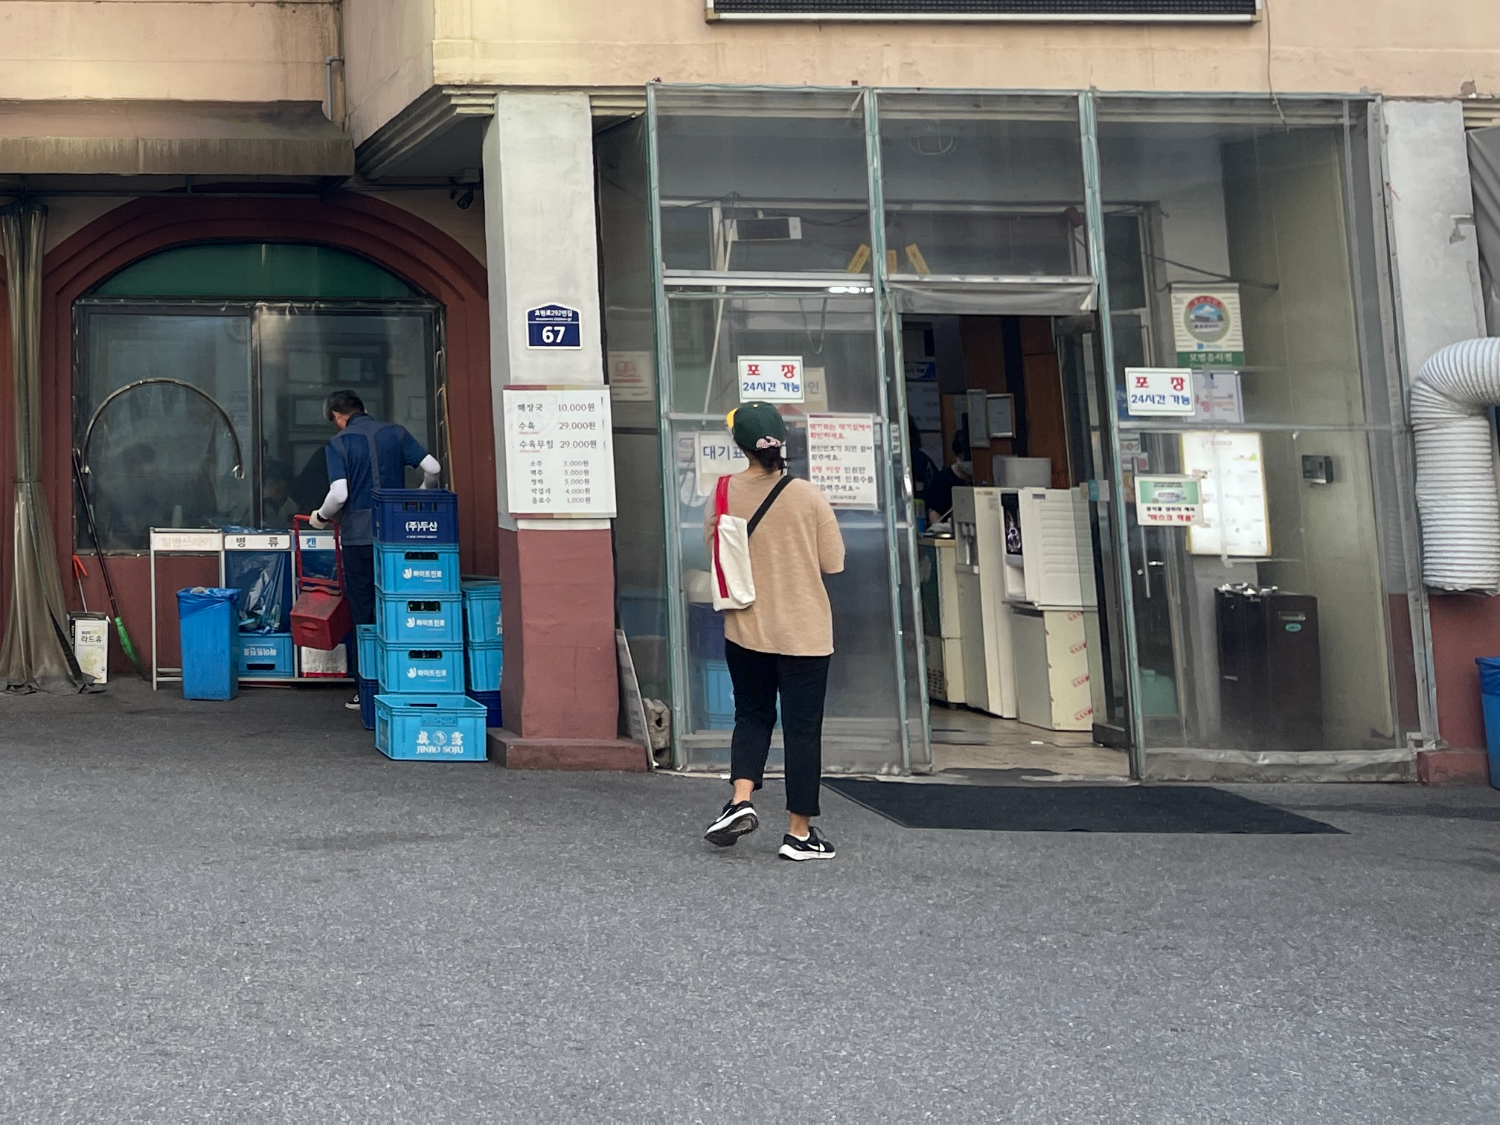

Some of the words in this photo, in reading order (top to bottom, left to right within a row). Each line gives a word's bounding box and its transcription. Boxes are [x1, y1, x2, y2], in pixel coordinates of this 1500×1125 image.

[542, 326, 565, 343] 67
[743, 382, 776, 392] 24시간
[780, 382, 800, 392] 가능
[1131, 394, 1166, 404] 24시간
[1169, 395, 1191, 405] 가능
[518, 403, 543, 412] 해장국
[558, 403, 595, 412] 10,000원
[518, 422, 535, 431] 수육
[559, 421, 596, 431] 29,000원
[560, 440, 597, 449] 29,000원
[405, 521, 438, 532] (주)두산
[306, 537, 317, 548] 캔
[413, 570, 442, 578] 하이트진로
[416, 618, 445, 626] 하이트진로
[81, 635, 102, 644] 라드유
[417, 668, 447, 677] 하이트진로
[416, 745, 441, 754] JINRO
[443, 745, 464, 755] SOJU
